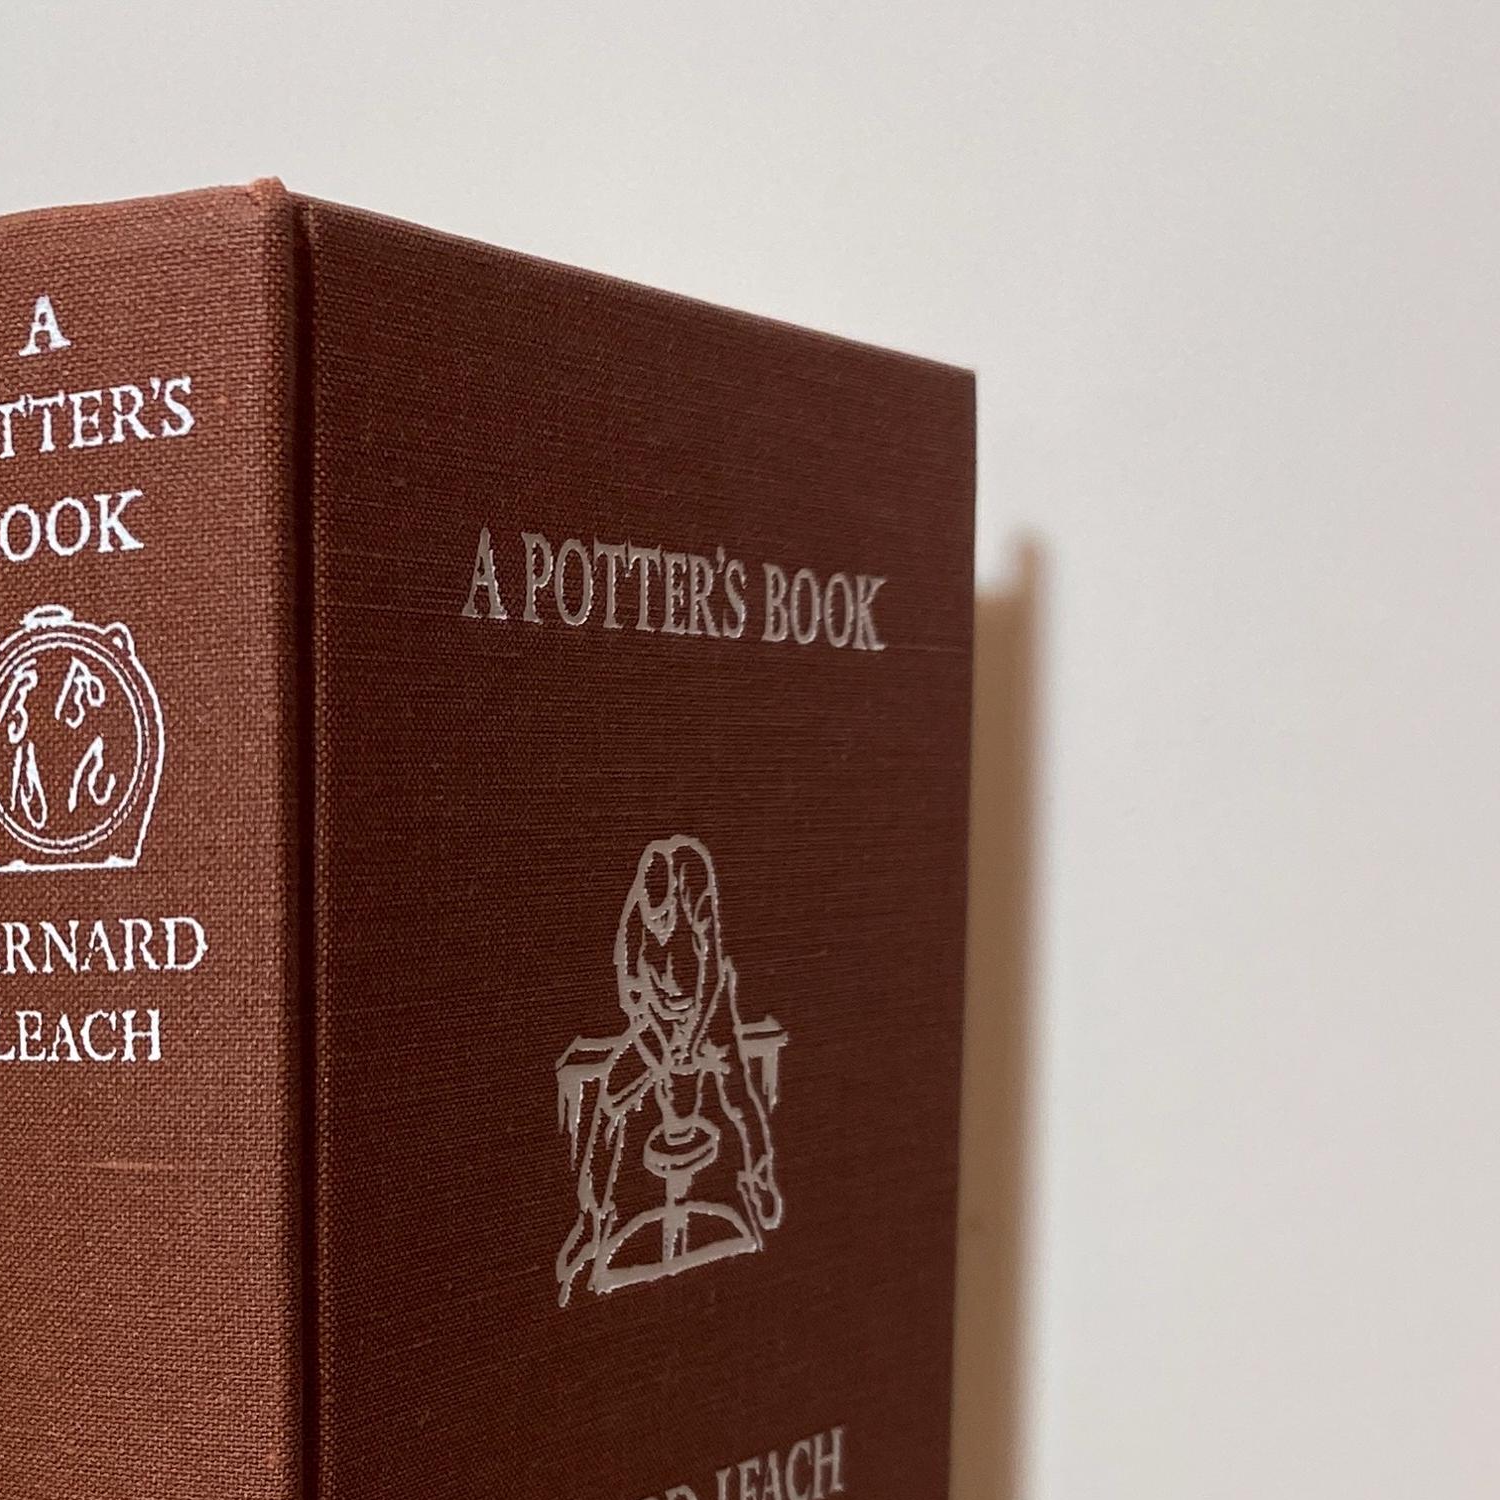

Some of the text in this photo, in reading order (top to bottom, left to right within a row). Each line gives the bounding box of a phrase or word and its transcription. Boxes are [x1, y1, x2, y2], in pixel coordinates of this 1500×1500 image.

[19, 295, 71, 356] A
[462, 532, 886, 650] A POTTER'S BOOK
